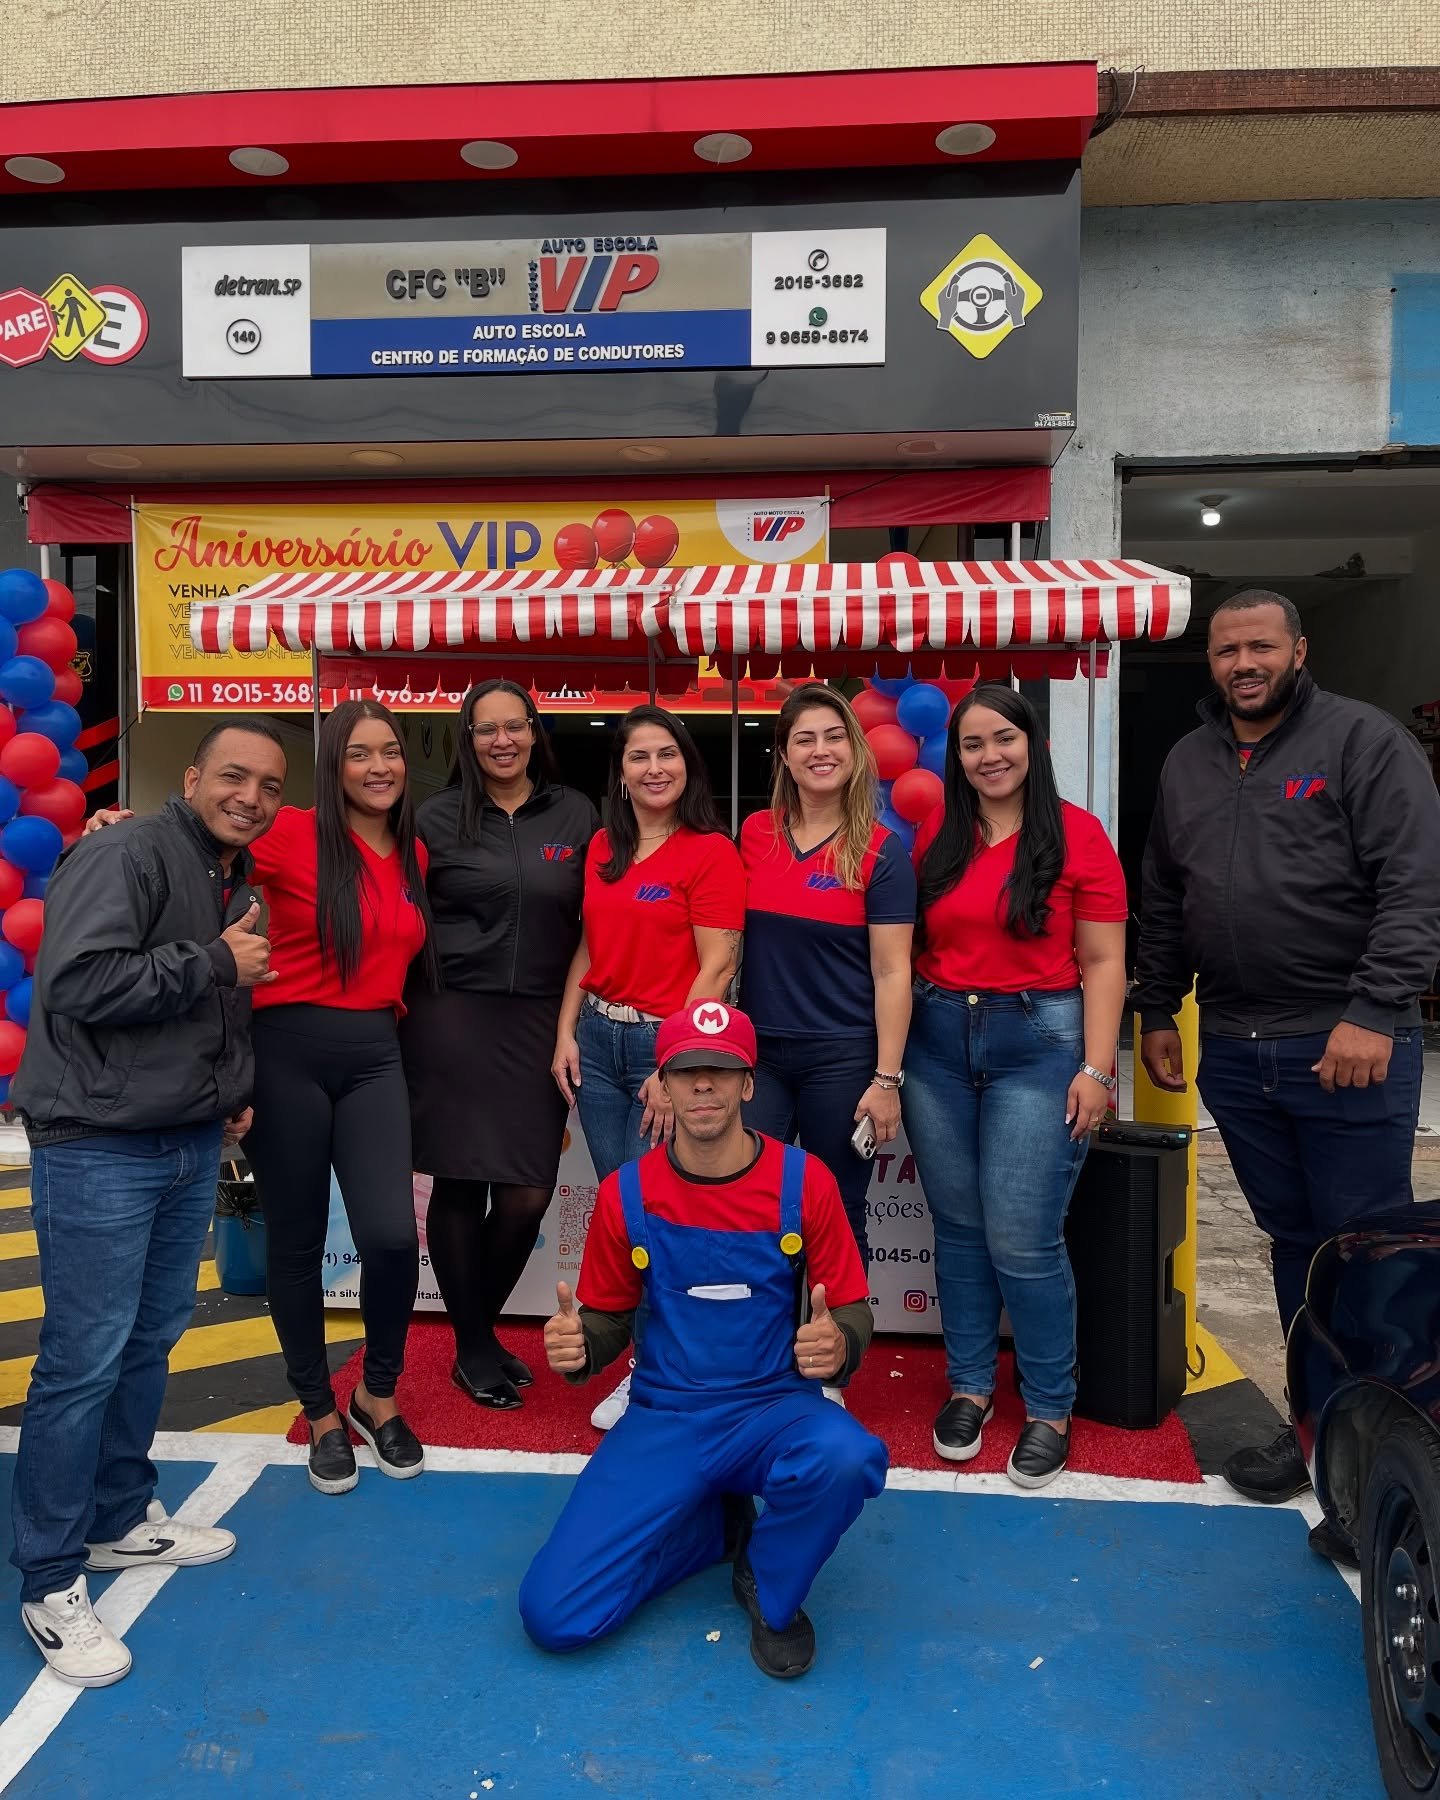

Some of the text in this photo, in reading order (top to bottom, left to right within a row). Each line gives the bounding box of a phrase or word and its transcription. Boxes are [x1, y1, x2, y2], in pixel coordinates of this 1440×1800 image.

[541, 236, 658, 254] AUTO ESCOLA
[214, 274, 302, 296] detran.SP
[386, 268, 447, 299] CFC
[540, 254, 660, 313] VIP
[774, 274, 864, 290] 2015-3682
[0, 307, 48, 341] ARE
[93, 300, 126, 350] E
[473, 323, 586, 340] AUTO ESCOLA
[232, 331, 256, 343] 140
[766, 329, 869, 345] 9 9659-8674
[371, 344, 685, 366] CENTRO DE FORMAÇÃO DE CONDUTORES
[753, 516, 806, 542] VIP
[154, 515, 541, 571] Aniversário VIP
[168, 584, 230, 598] VENHA
[188, 683, 202, 702] 11
[1285, 779, 1327, 799] VIP
[543, 847, 574, 862] VIP
[635, 884, 671, 903] VIP
[698, 1009, 723, 1027] M
[865, 1194, 924, 1225] ações
[339, 1289, 361, 1298] silv
